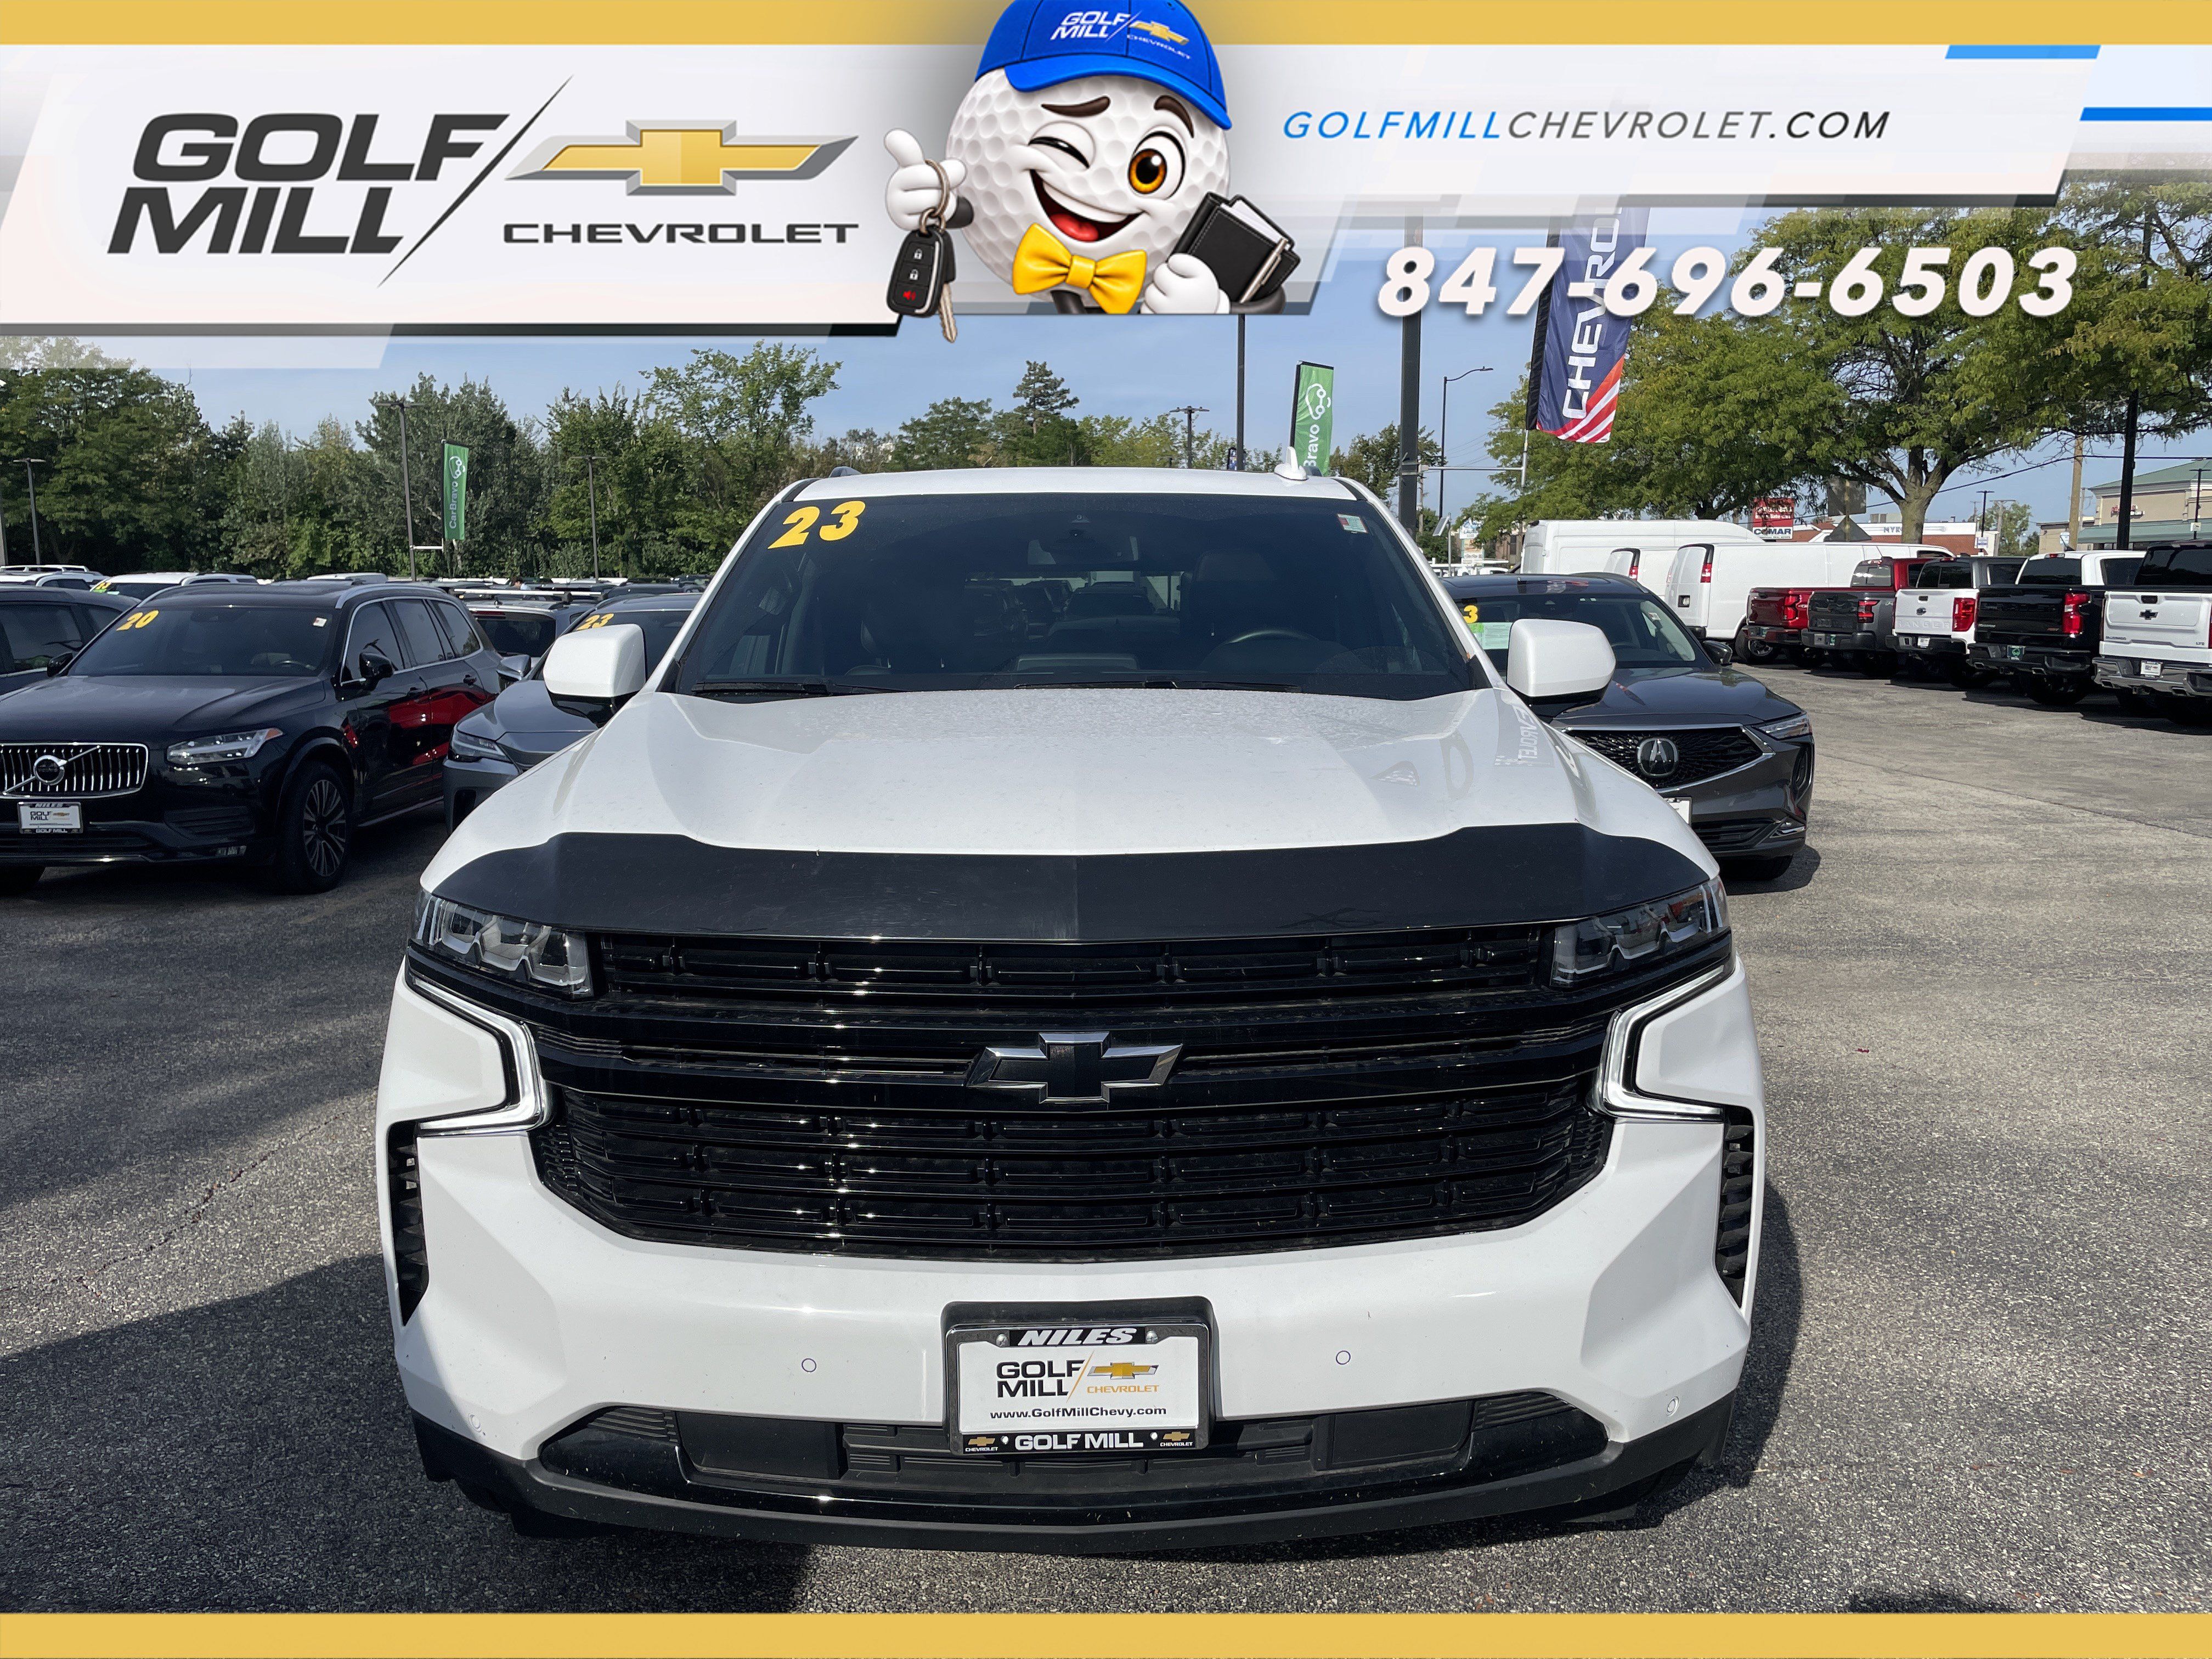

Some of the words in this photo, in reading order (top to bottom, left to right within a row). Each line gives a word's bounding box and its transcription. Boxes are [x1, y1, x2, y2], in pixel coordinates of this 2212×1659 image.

[449, 481, 459, 529] CarBravo
[768, 500, 866, 549] 23
[116, 610, 160, 631] 20
[575, 613, 614, 630] 23
[1018, 1328, 1137, 1346] NILES
[996, 1359, 1085, 1379] GOLF
[997, 1380, 1069, 1398] MILL
[1087, 1384, 1160, 1394] CHEVROLET
[990, 1406, 1167, 1419] www.GolfMillChevy.com
[1015, 1433, 1081, 1451] GOLF
[1085, 1432, 1143, 1449] MILL
